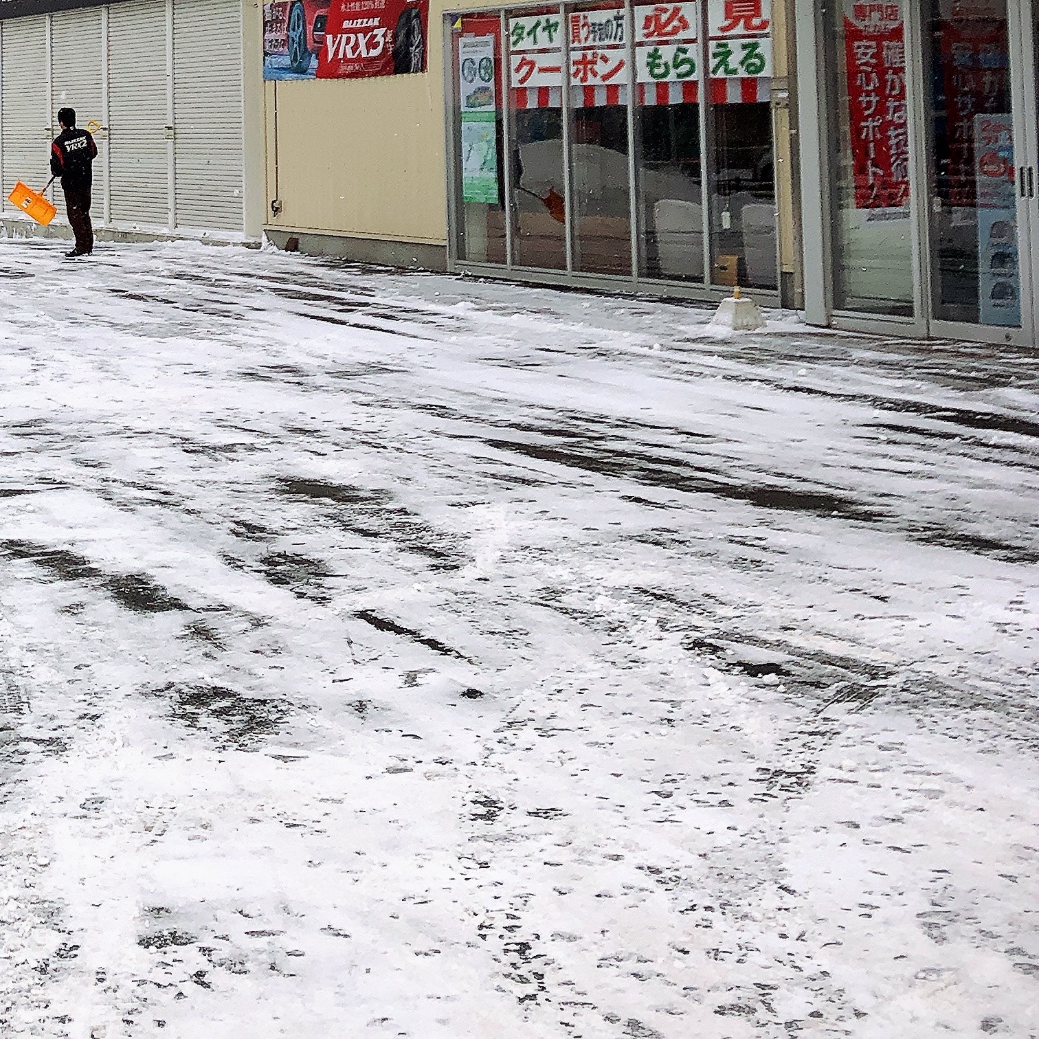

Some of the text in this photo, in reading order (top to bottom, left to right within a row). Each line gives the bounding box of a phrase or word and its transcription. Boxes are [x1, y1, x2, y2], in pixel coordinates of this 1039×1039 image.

[342, 17, 381, 29] BLIZZAK
[853, 4, 899, 22] 専門店
[326, 28, 388, 63] VRX3
[511, 18, 560, 46] タイヤ
[514, 41, 766, 83] クーポン もらえる
